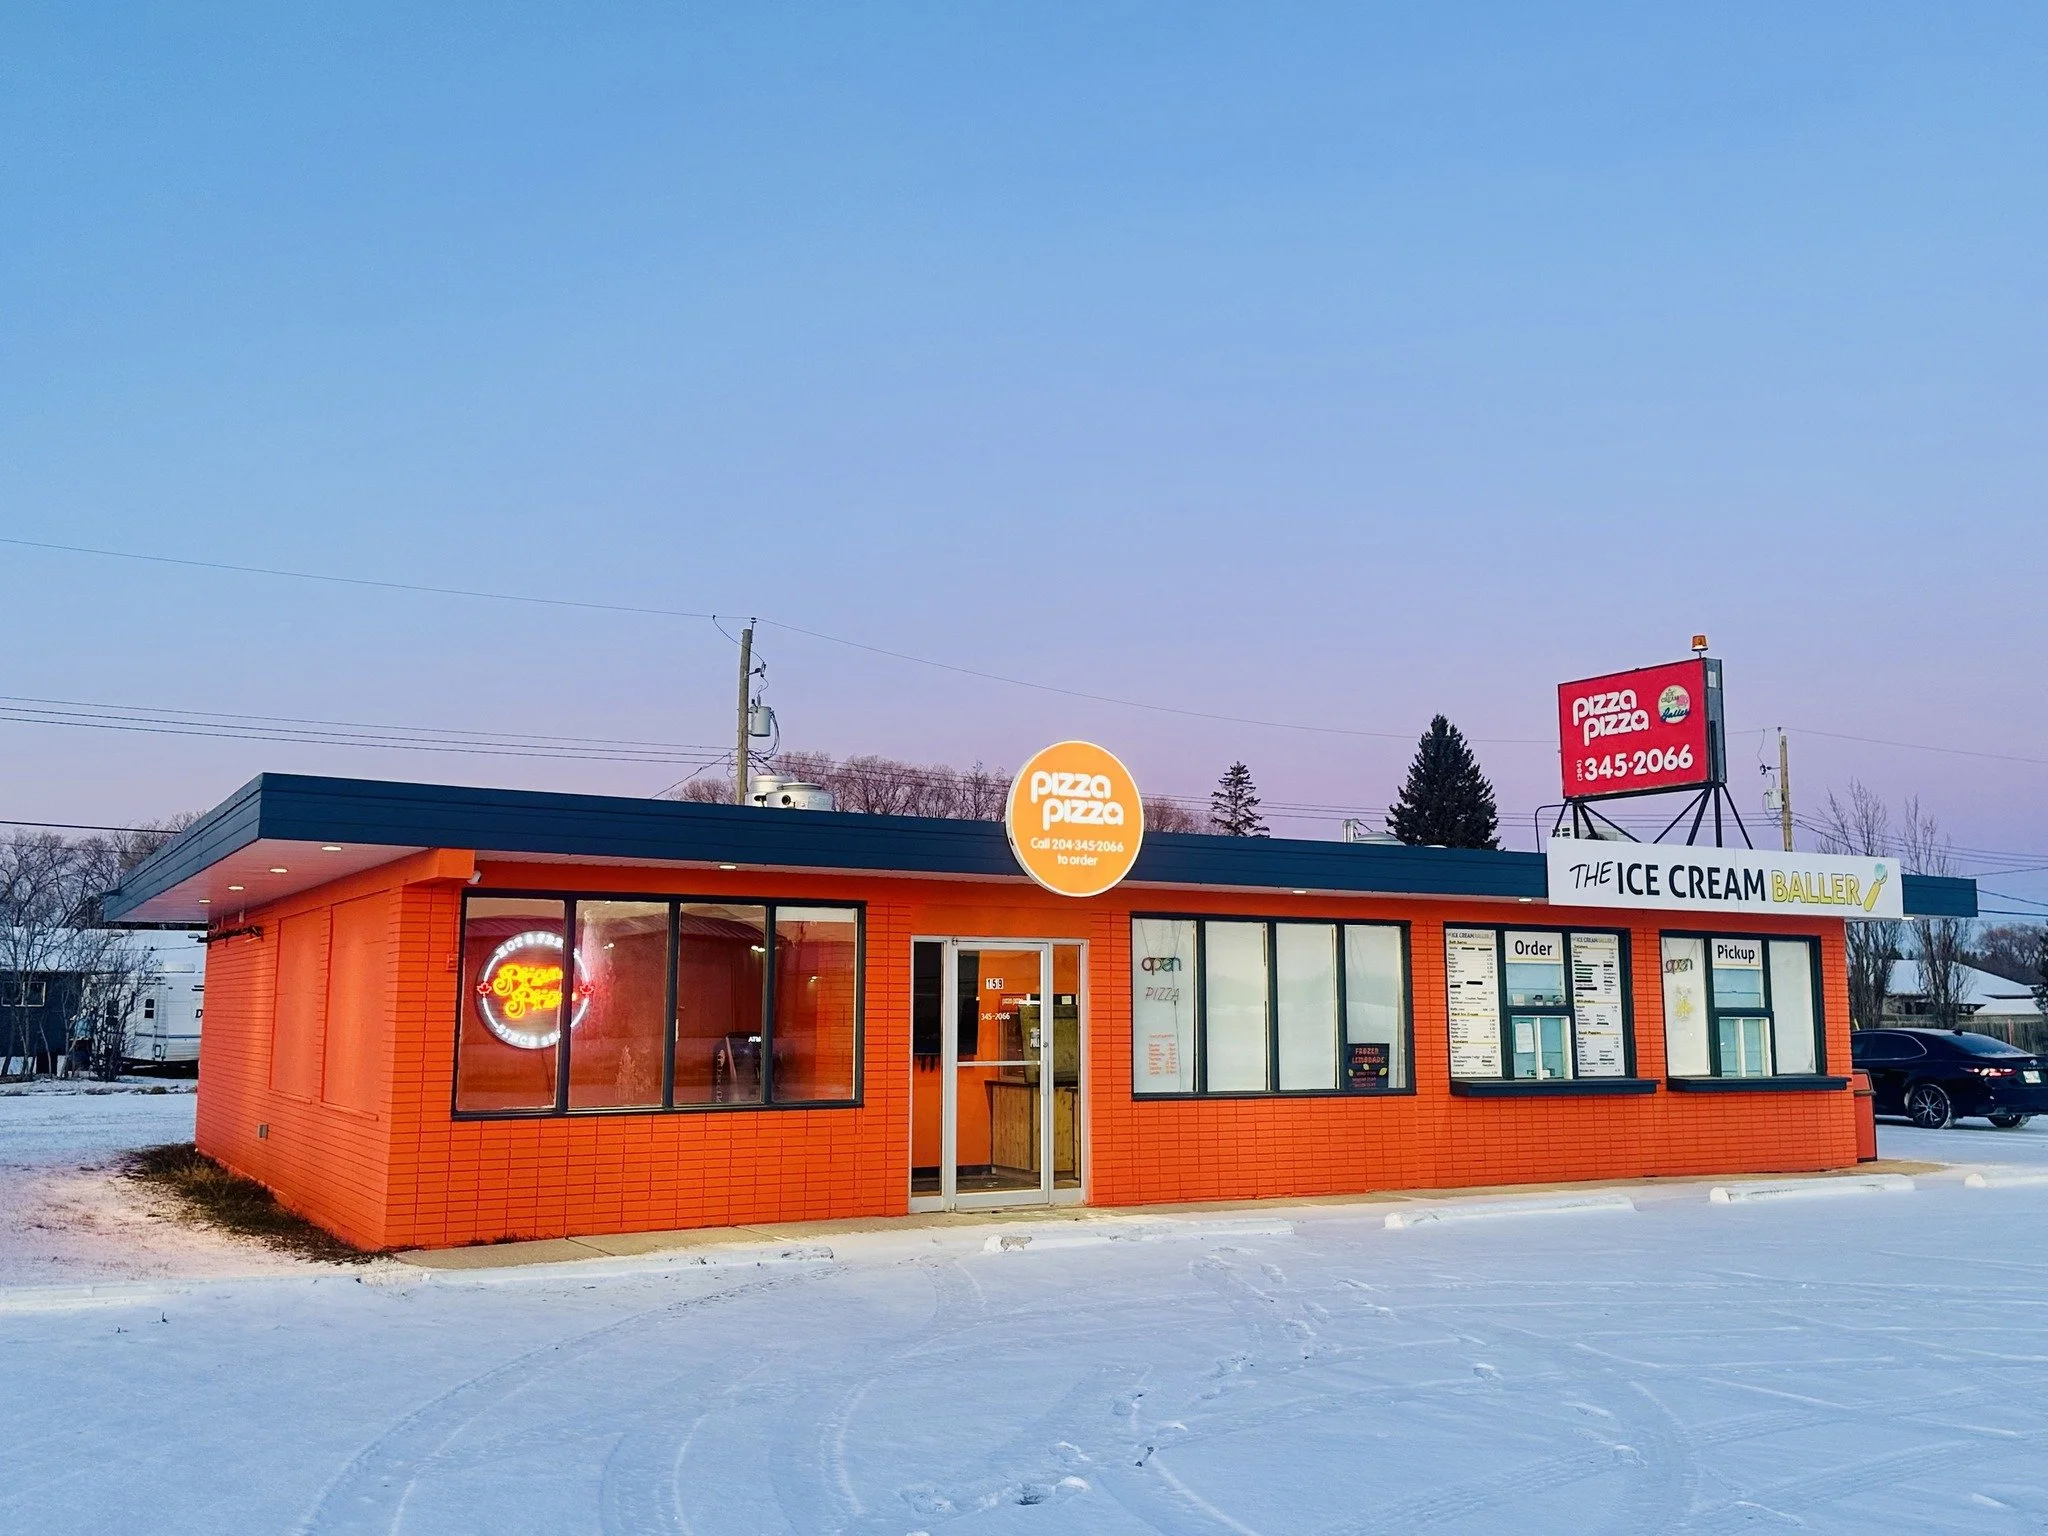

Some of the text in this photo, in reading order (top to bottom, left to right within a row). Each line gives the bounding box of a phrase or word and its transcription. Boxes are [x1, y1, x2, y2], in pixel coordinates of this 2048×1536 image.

[1572, 689, 1637, 726] pizza
[1583, 709, 1649, 746] pizza
[1030, 771, 1111, 804] pizza
[1042, 798, 1124, 831] pizza
[1030, 837, 1050, 850] Call
[1057, 854, 1098, 867] to order
[1569, 860, 1862, 906] THE ICE CREAM BALLER
[1515, 940, 1552, 956] Order
[1717, 945, 1755, 963] Pickup
[1141, 957, 1182, 976] open
[1145, 986, 1179, 1001] PIZZA
